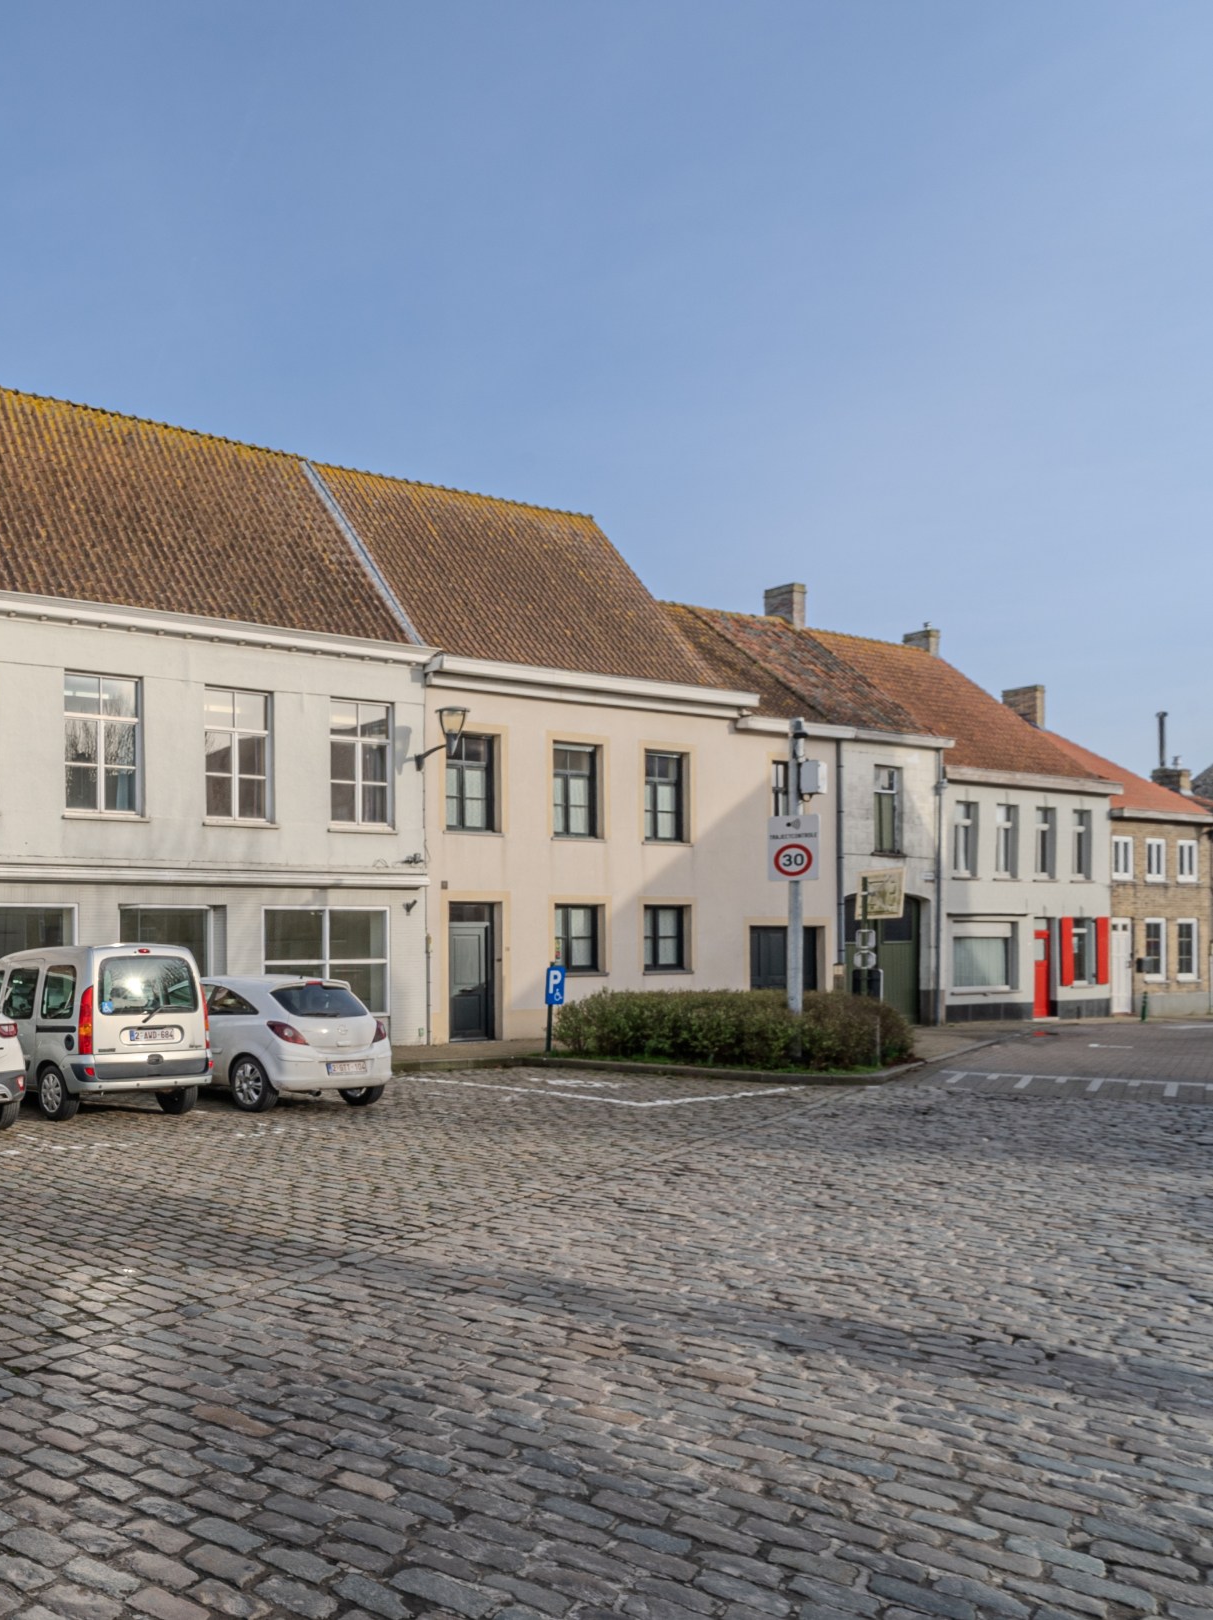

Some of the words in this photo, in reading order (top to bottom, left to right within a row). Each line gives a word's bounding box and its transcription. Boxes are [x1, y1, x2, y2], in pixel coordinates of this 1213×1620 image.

[769, 831, 818, 840] TRAJECTCONTROLE
[782, 853, 805, 867] 30
[548, 970, 562, 994] P
